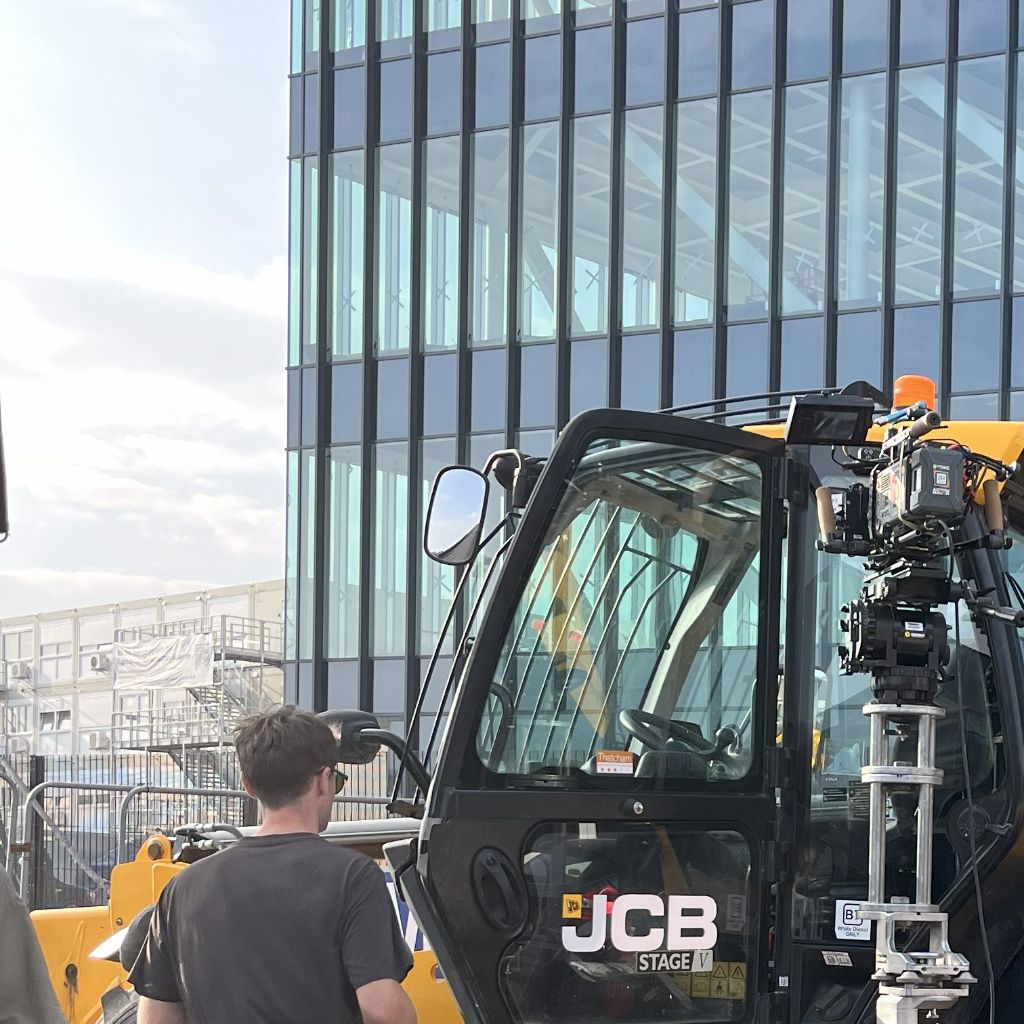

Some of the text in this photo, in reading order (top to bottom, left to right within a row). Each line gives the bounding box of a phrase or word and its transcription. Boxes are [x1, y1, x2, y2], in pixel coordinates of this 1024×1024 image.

[562, 894, 718, 952] JCB
[639, 952, 709, 971] STAGE V
